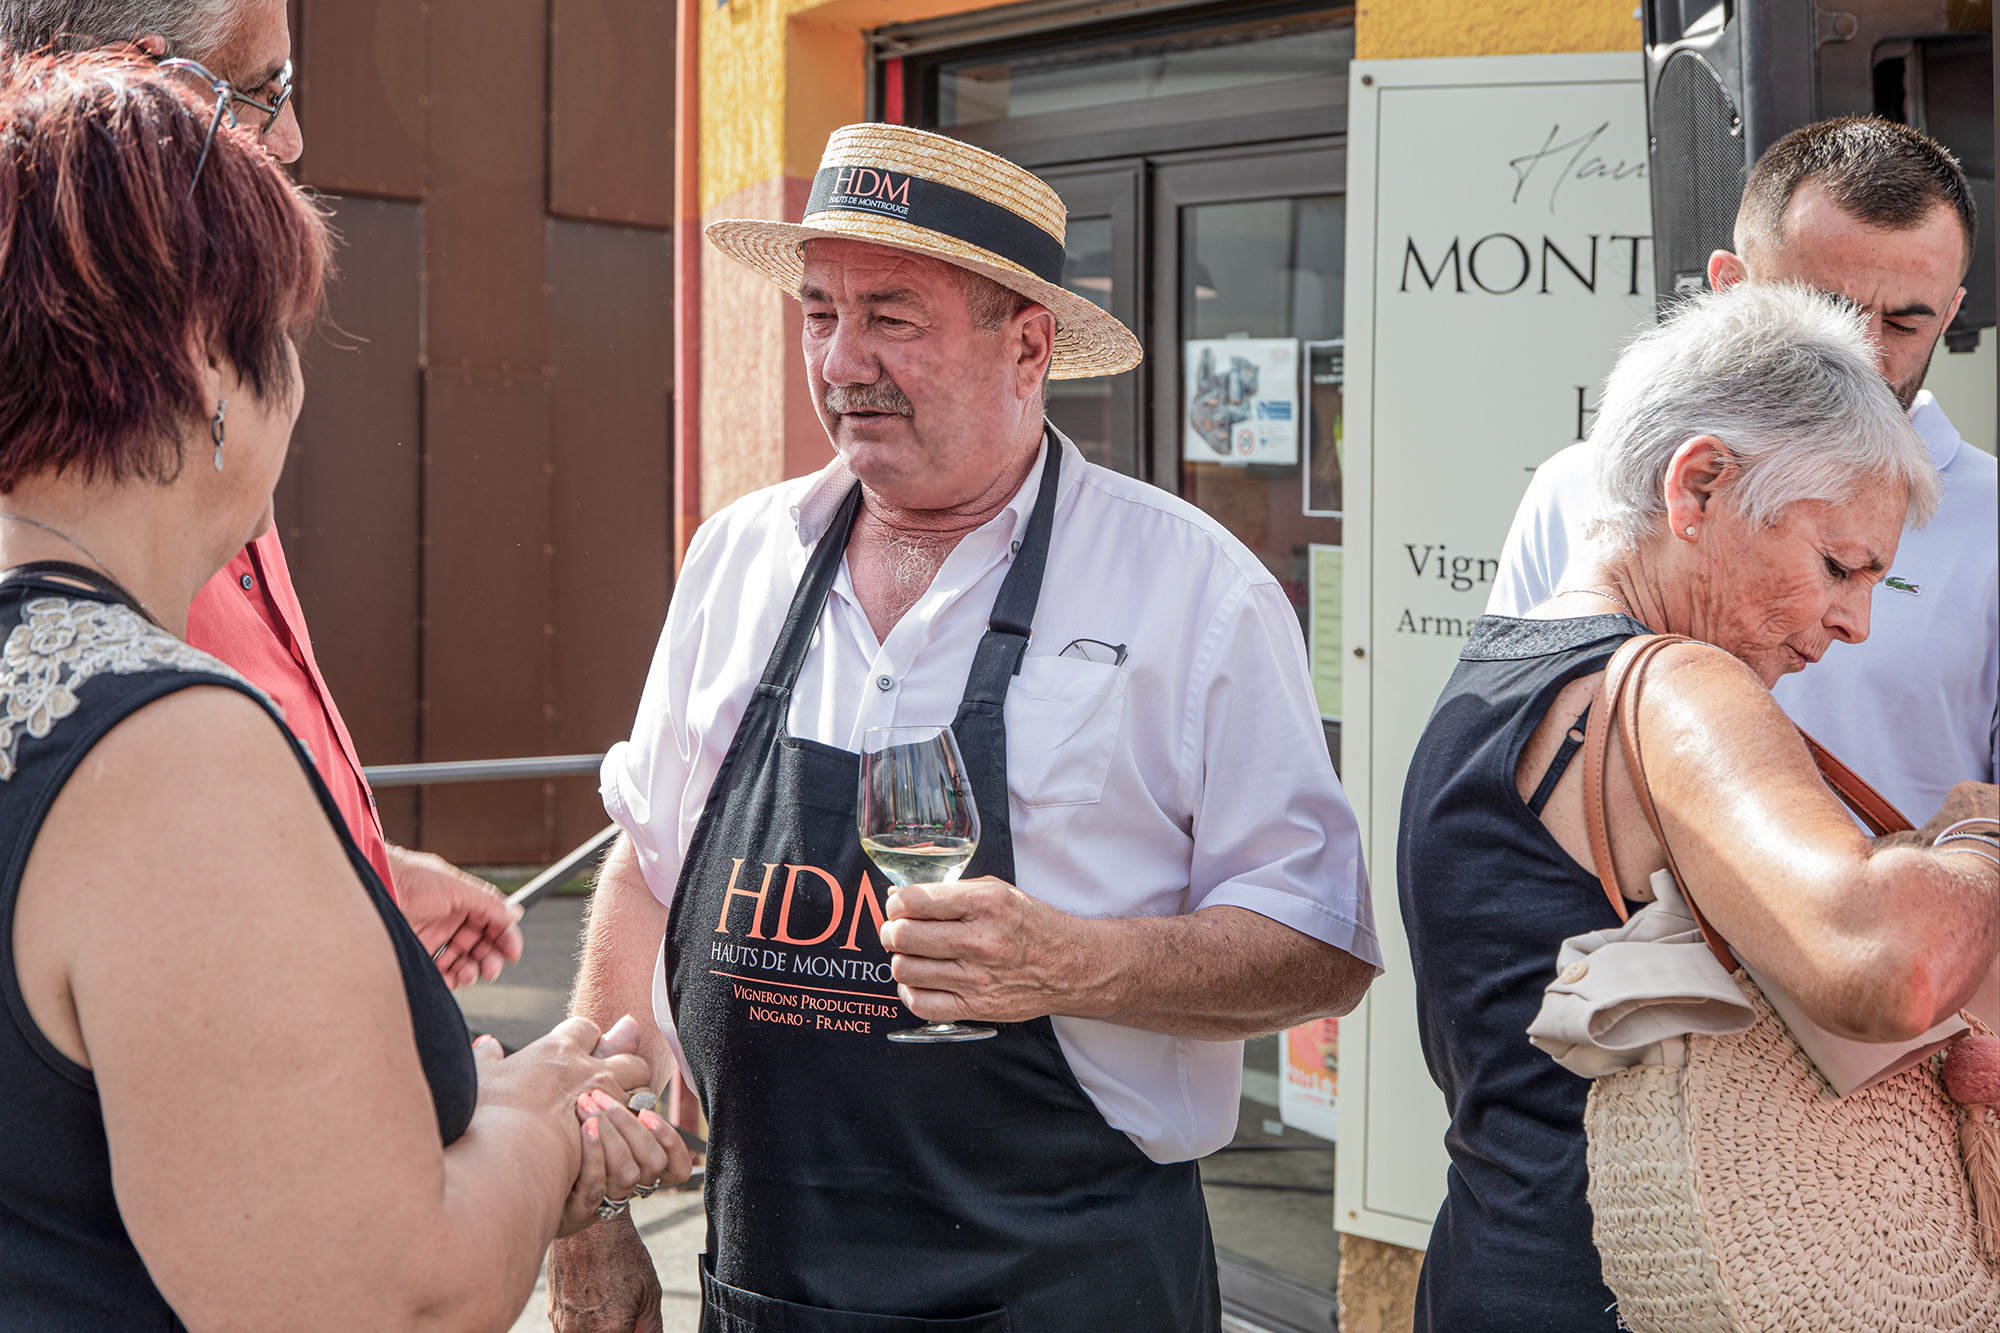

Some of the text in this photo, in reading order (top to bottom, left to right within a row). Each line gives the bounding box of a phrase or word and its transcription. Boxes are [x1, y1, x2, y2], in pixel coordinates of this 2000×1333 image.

[829, 196, 909, 215] HAUTS DE MONTROUGE
[831, 167, 911, 206] HDM
[1399, 233, 1654, 295] MONT
[1403, 543, 1499, 592] Vign
[710, 942, 894, 984] HAUTS DE MONTRO
[733, 983, 898, 1019] VIGNERONS PRODUCTEURS
[749, 1005, 803, 1027] NOGARO
[815, 1014, 871, 1034] FRANCE
